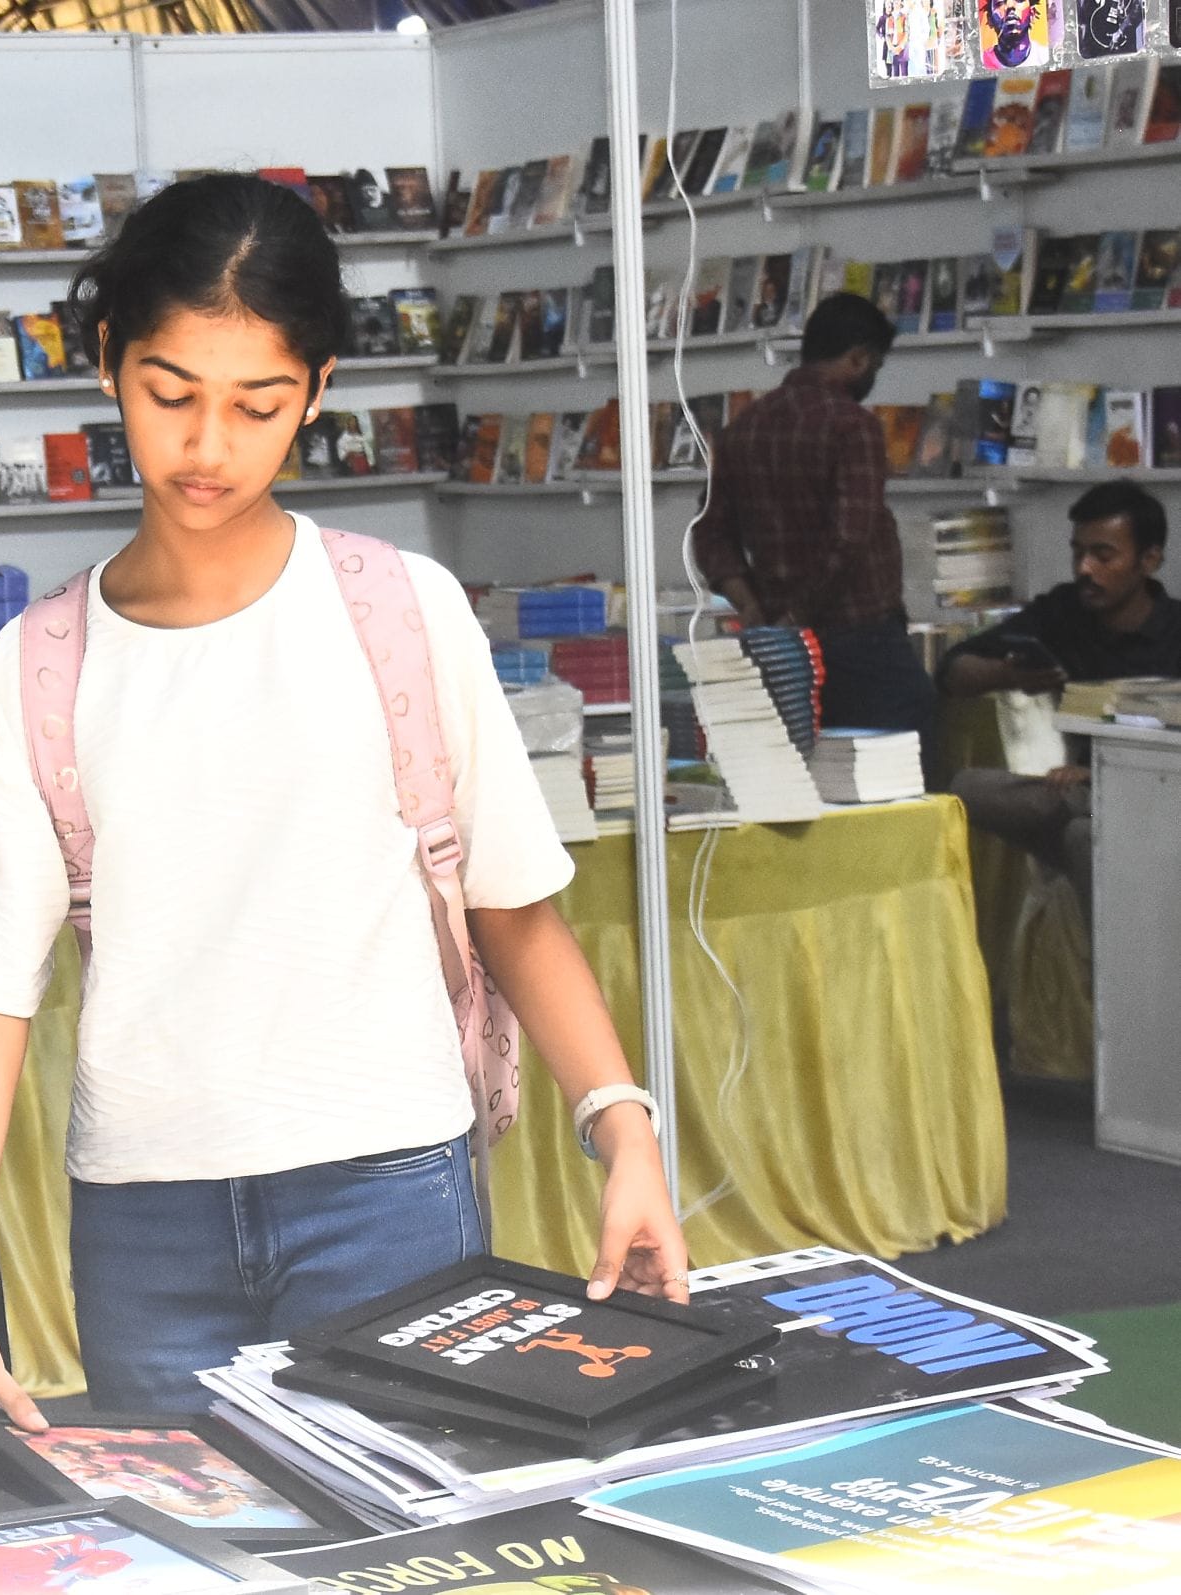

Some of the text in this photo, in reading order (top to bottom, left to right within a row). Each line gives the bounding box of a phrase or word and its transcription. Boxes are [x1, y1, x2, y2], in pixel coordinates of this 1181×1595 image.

[377, 1289, 517, 1348] CRYING
[419, 1299, 542, 1353] IS JUST FAT
[438, 1303, 583, 1365] SWEAT
[762, 1274, 1048, 1375] DHONI
[918, 1455, 950, 1468] 4:12
[950, 1464, 1022, 1487] TIMOTHY
[761, 1479, 889, 1517] example
[495, 1535, 586, 1570] NO
